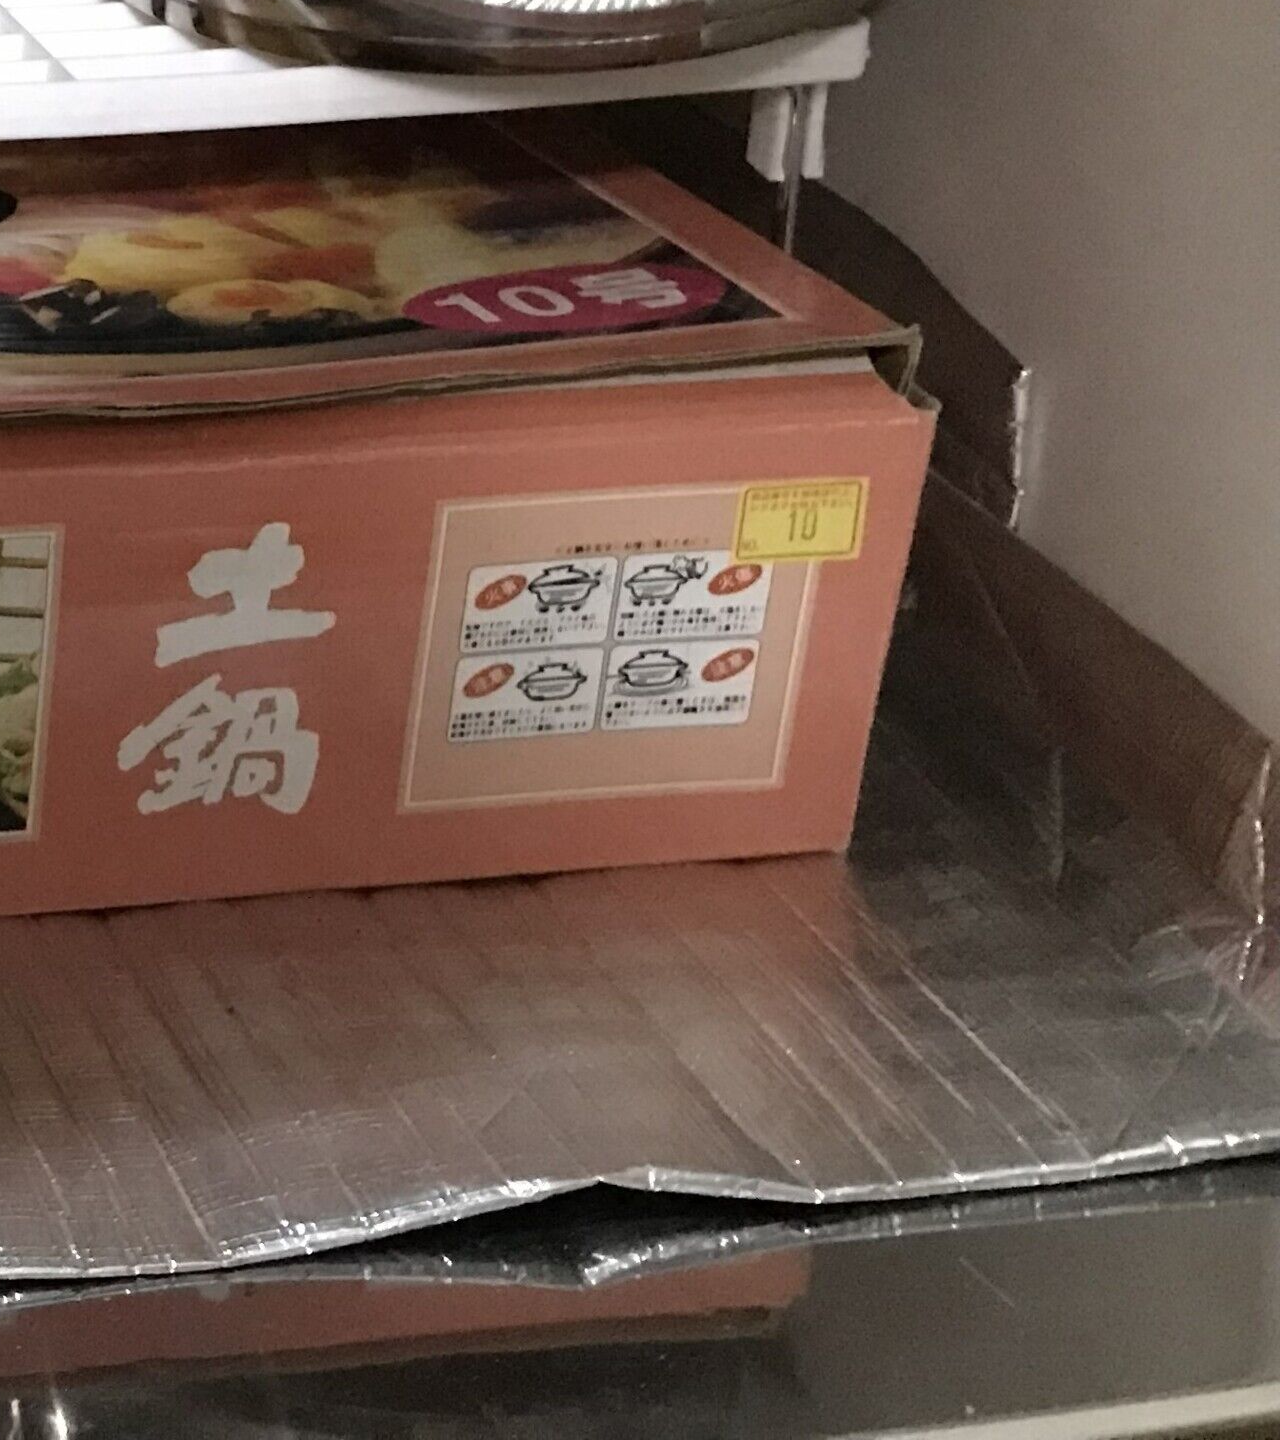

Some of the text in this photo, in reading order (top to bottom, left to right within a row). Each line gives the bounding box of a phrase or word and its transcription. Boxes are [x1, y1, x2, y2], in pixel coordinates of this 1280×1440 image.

[434, 267, 688, 324] 10号
[788, 509, 819, 542] 10
[116, 521, 337, 815] 土鍋
